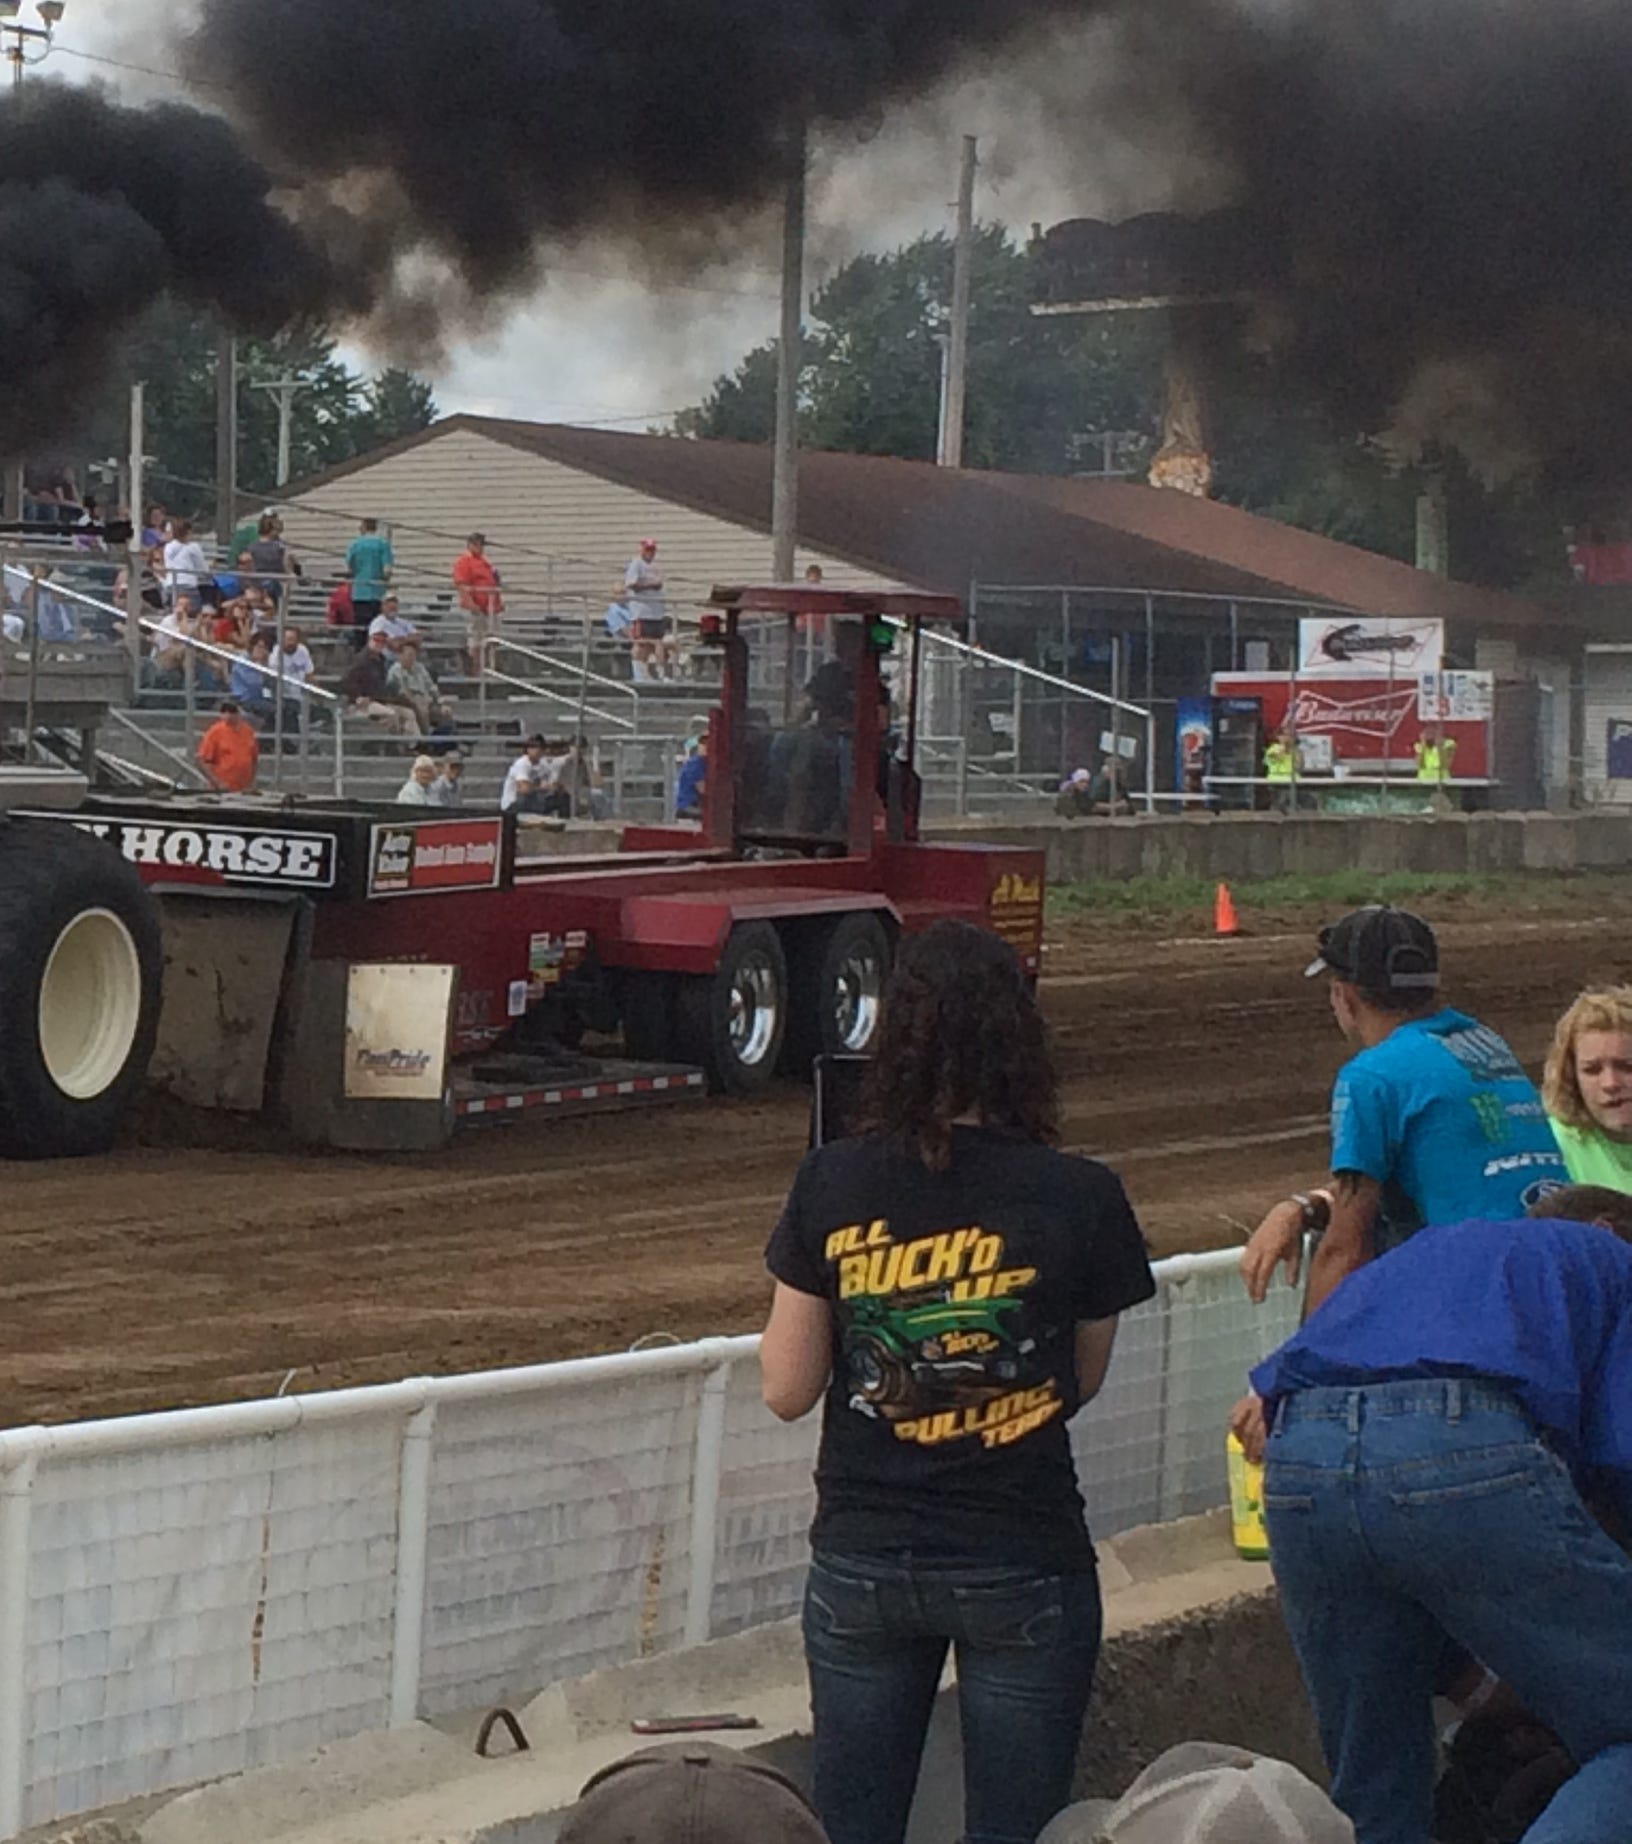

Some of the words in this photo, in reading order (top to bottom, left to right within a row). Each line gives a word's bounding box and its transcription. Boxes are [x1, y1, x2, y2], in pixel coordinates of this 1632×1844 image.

[120, 826, 323, 878] HORSE
[825, 1218, 893, 1261] ALL
[839, 1227, 1003, 1300] BUCK'D
[953, 1267, 1036, 1302] UP
[893, 1376, 1056, 1443] PULLING
